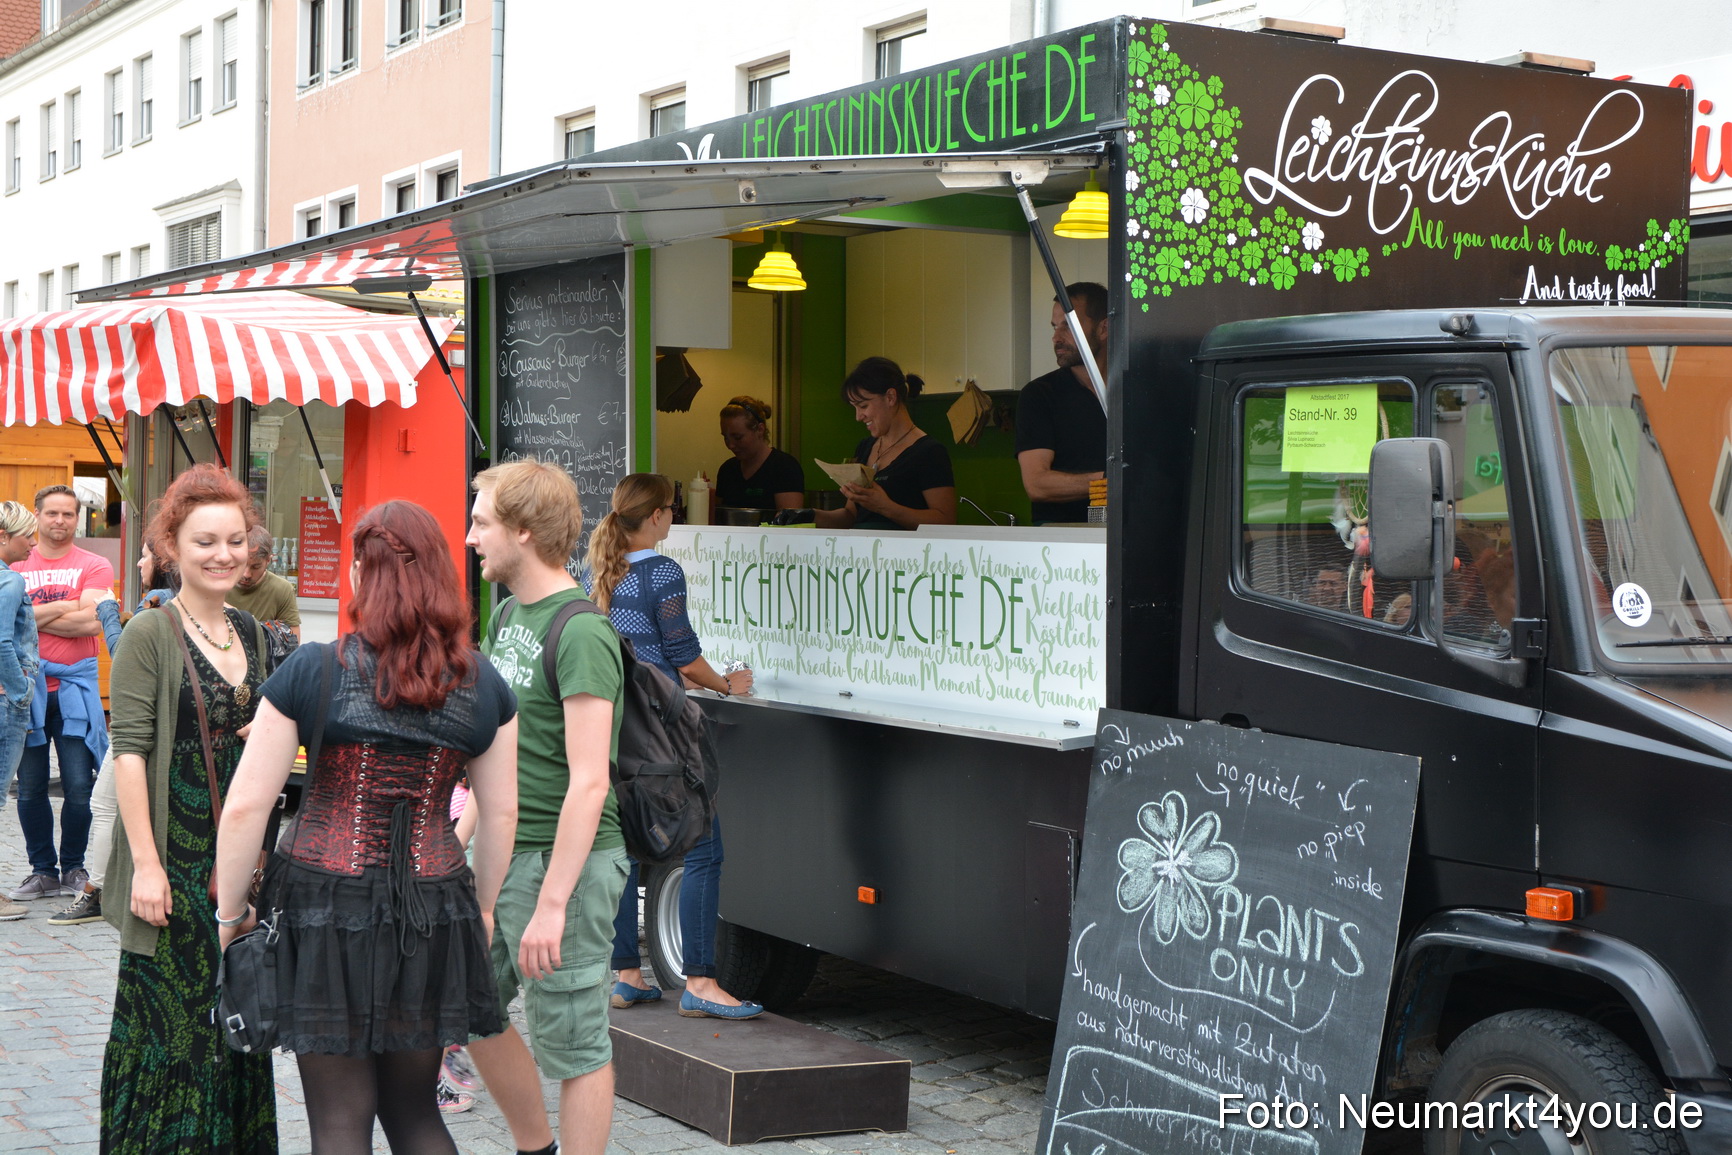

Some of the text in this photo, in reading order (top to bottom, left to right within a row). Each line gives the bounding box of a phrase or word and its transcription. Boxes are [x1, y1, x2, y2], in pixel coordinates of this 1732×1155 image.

[742, 33, 1097, 159] LEICHTSINNSKUECHE.DE
[1401, 206, 1601, 261] All you need is love.
[505, 286, 543, 314] Servus
[1518, 264, 1658, 306] And tasty food!
[517, 319, 531, 332] uns
[1288, 407, 1358, 421] Stand-Nr. 39
[1309, 393, 1350, 401] Altstadtfest 2017
[694, 532, 722, 564] Grün
[759, 534, 824, 568] Geschmack
[871, 538, 921, 574] Genuss
[968, 545, 1041, 580] Vitamine
[1041, 545, 1101, 586] Snacks
[711, 560, 1024, 655] LEICHTSINNSKUECHE.DE
[1026, 608, 1101, 649] Köstlich
[1030, 583, 1104, 632] Vielfalt
[743, 611, 784, 644] Gesund
[884, 624, 936, 660] Aroma
[993, 633, 1038, 681] Spass
[1038, 639, 1098, 690] Rezept
[757, 641, 796, 681] Vegan
[845, 648, 920, 687] Goldbraun
[919, 660, 985, 698] Moment
[984, 663, 1032, 702] Sauce
[1032, 669, 1101, 712] Gaumen
[1100, 755, 1122, 775] no
[1216, 760, 1239, 782] no
[1296, 843, 1319, 860] no
[1209, 946, 1307, 1023] ONLY
[1076, 1009, 1106, 1034] aus
[1081, 968, 1327, 1087] handgemacht mit Zutaten
